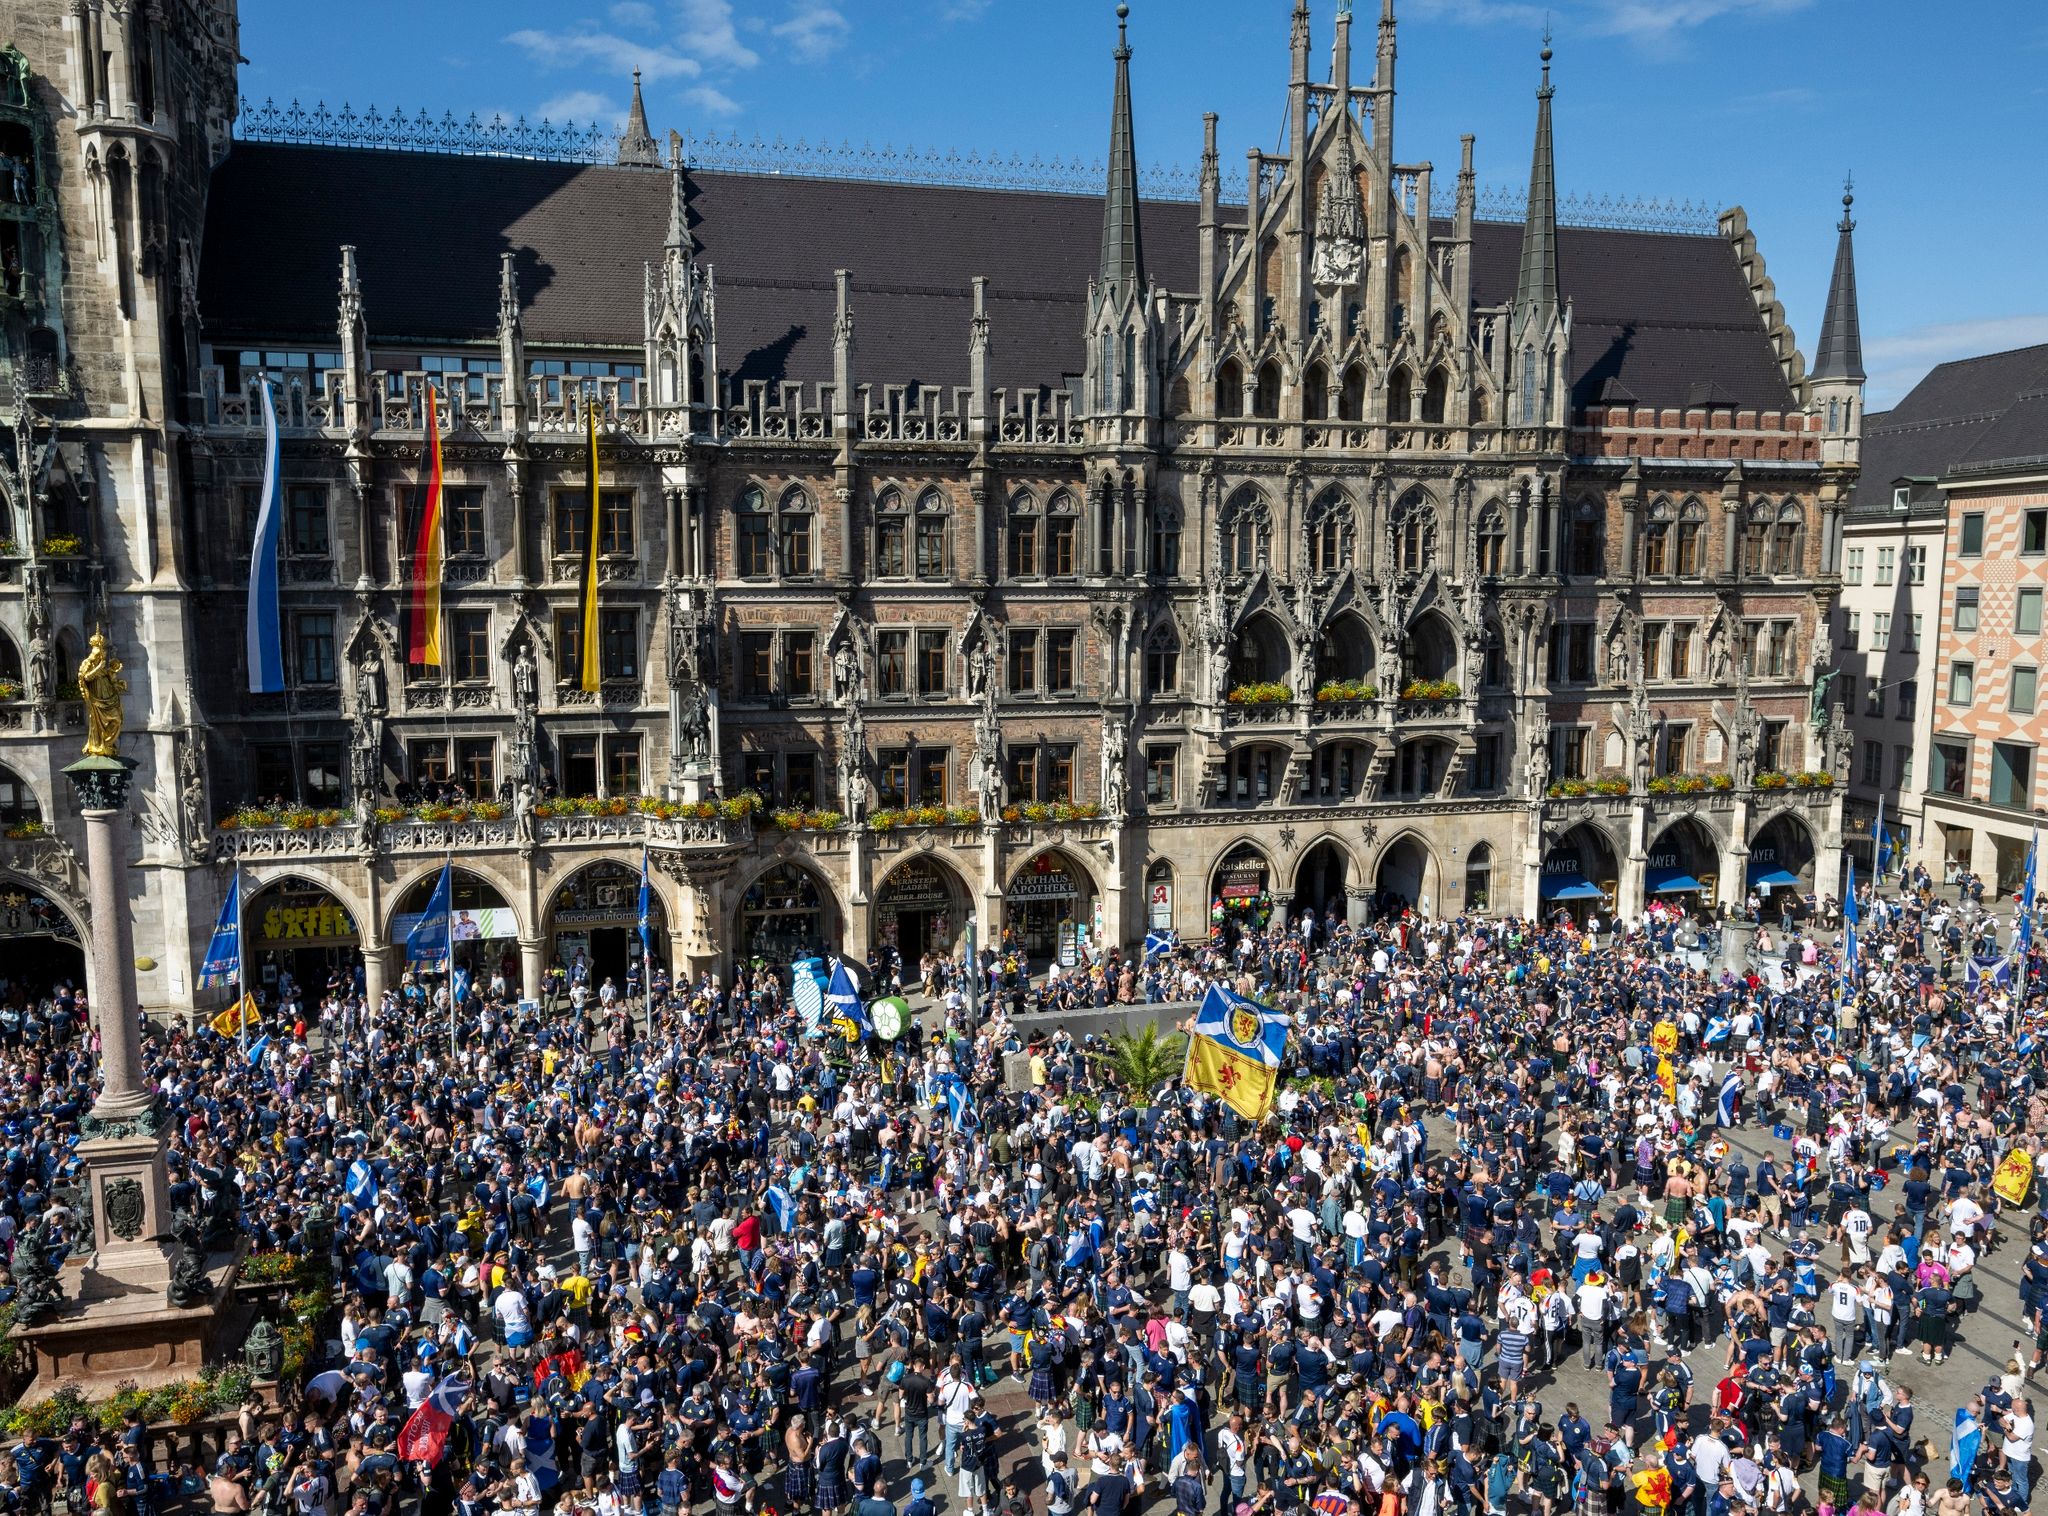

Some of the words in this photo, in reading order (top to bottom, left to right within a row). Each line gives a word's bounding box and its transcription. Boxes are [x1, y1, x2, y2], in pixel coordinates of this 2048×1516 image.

[1218, 859, 1266, 871] Ratskeller
[1546, 859, 1578, 873] MAYER
[1016, 874, 1068, 885] RATHAUS
[1009, 882, 1075, 895] APOTHEKE
[917, 892, 944, 900] HOUSE
[265, 906, 346, 925] COFFEE
[554, 911, 601, 923] München
[603, 911, 660, 921] Informaon
[263, 919, 350, 939] WATER
[966, 926, 971, 943] S
[1808, 1069, 1815, 1079] 3
[1854, 1220, 1867, 1232] 10
[895, 1282, 908, 1296] 10
[1839, 1291, 1848, 1306] 8
[1517, 1305, 1528, 1320] 17
